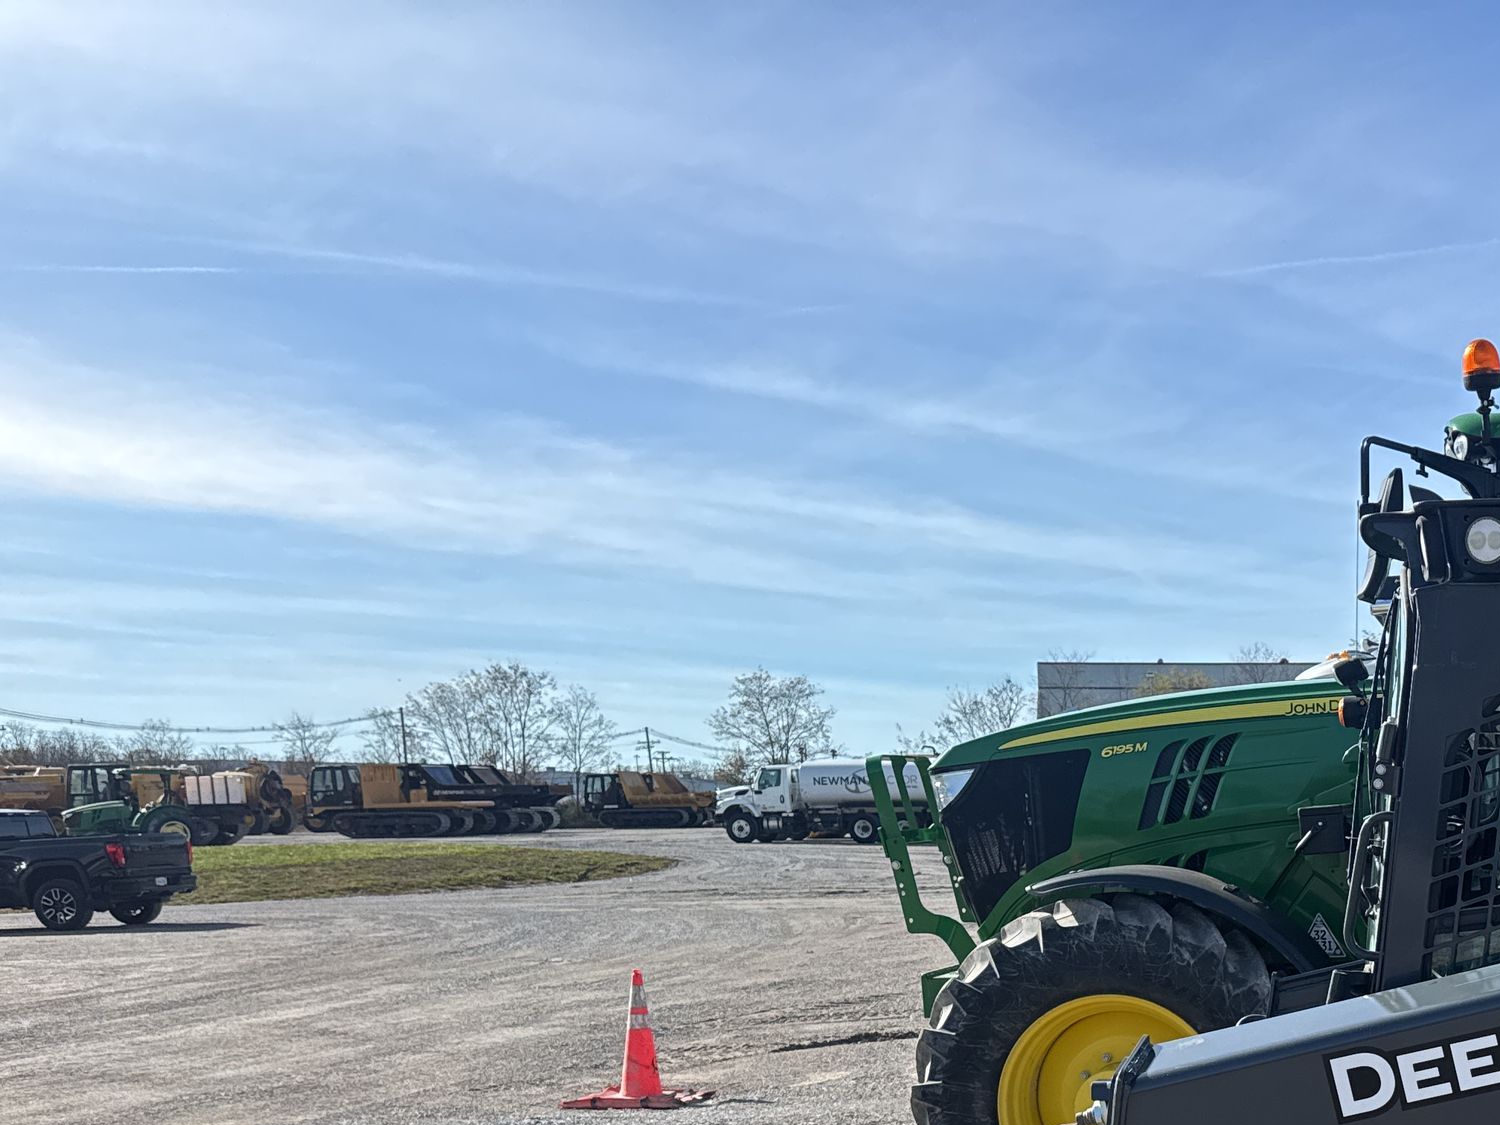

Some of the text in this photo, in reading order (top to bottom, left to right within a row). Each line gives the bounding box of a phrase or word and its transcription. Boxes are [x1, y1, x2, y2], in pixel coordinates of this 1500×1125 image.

[1285, 702, 1327, 715] JOHN
[813, 776, 867, 786] NEWMAN
[1313, 930, 1327, 941] 32
